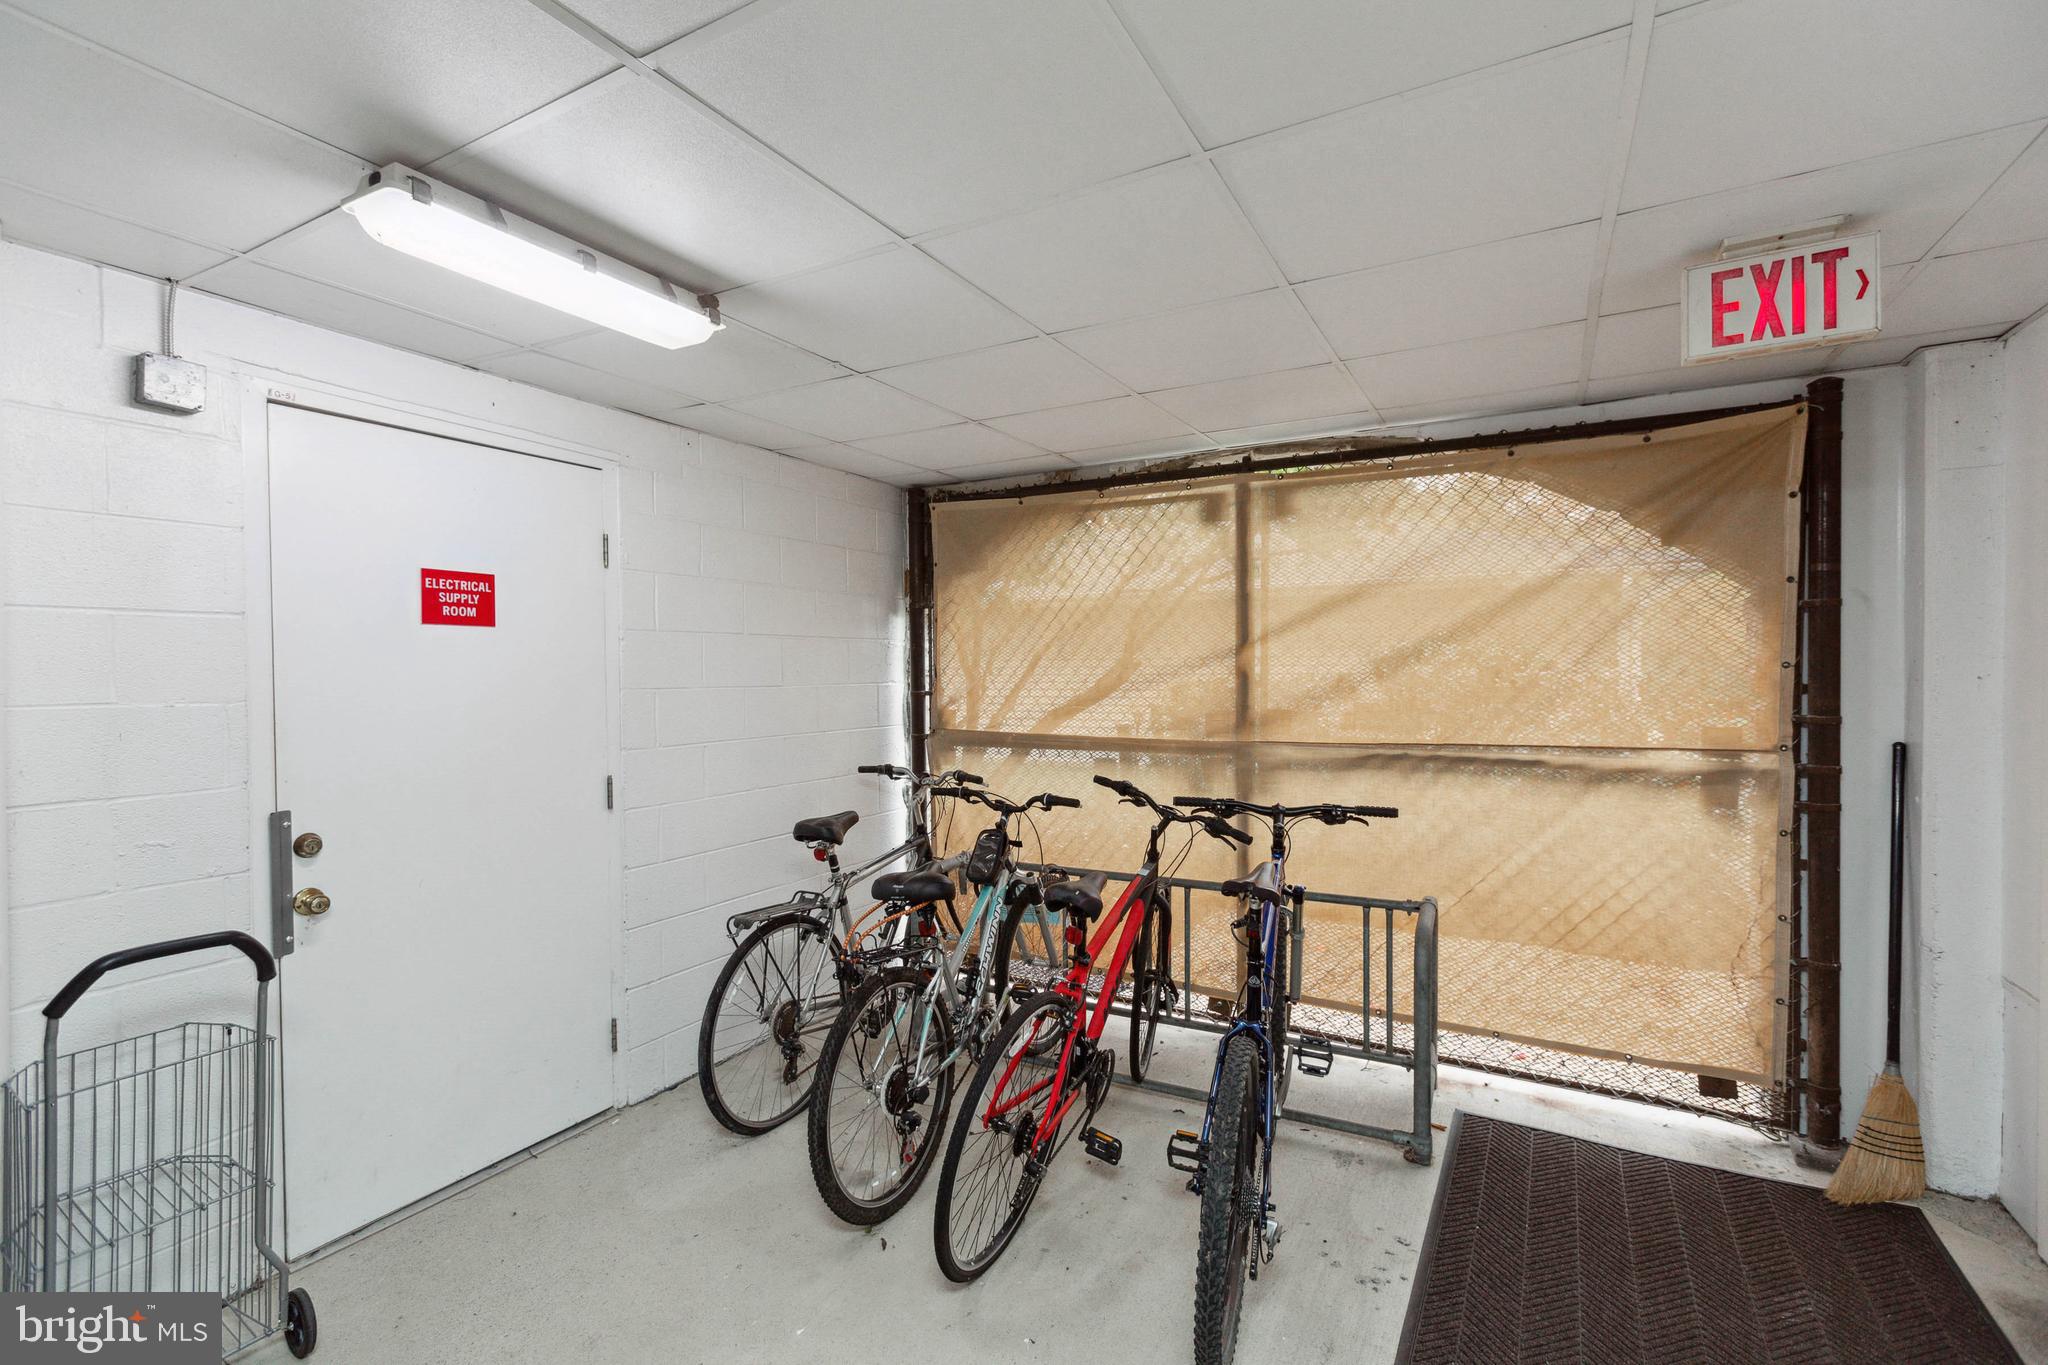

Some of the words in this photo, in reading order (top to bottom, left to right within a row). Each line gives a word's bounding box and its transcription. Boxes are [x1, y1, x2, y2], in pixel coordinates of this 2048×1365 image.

[1711, 246, 1849, 348] EXIT
[425, 577, 492, 592] ELECTRICAL
[438, 591, 480, 604] SUPPLY
[442, 605, 477, 617] ROOM
